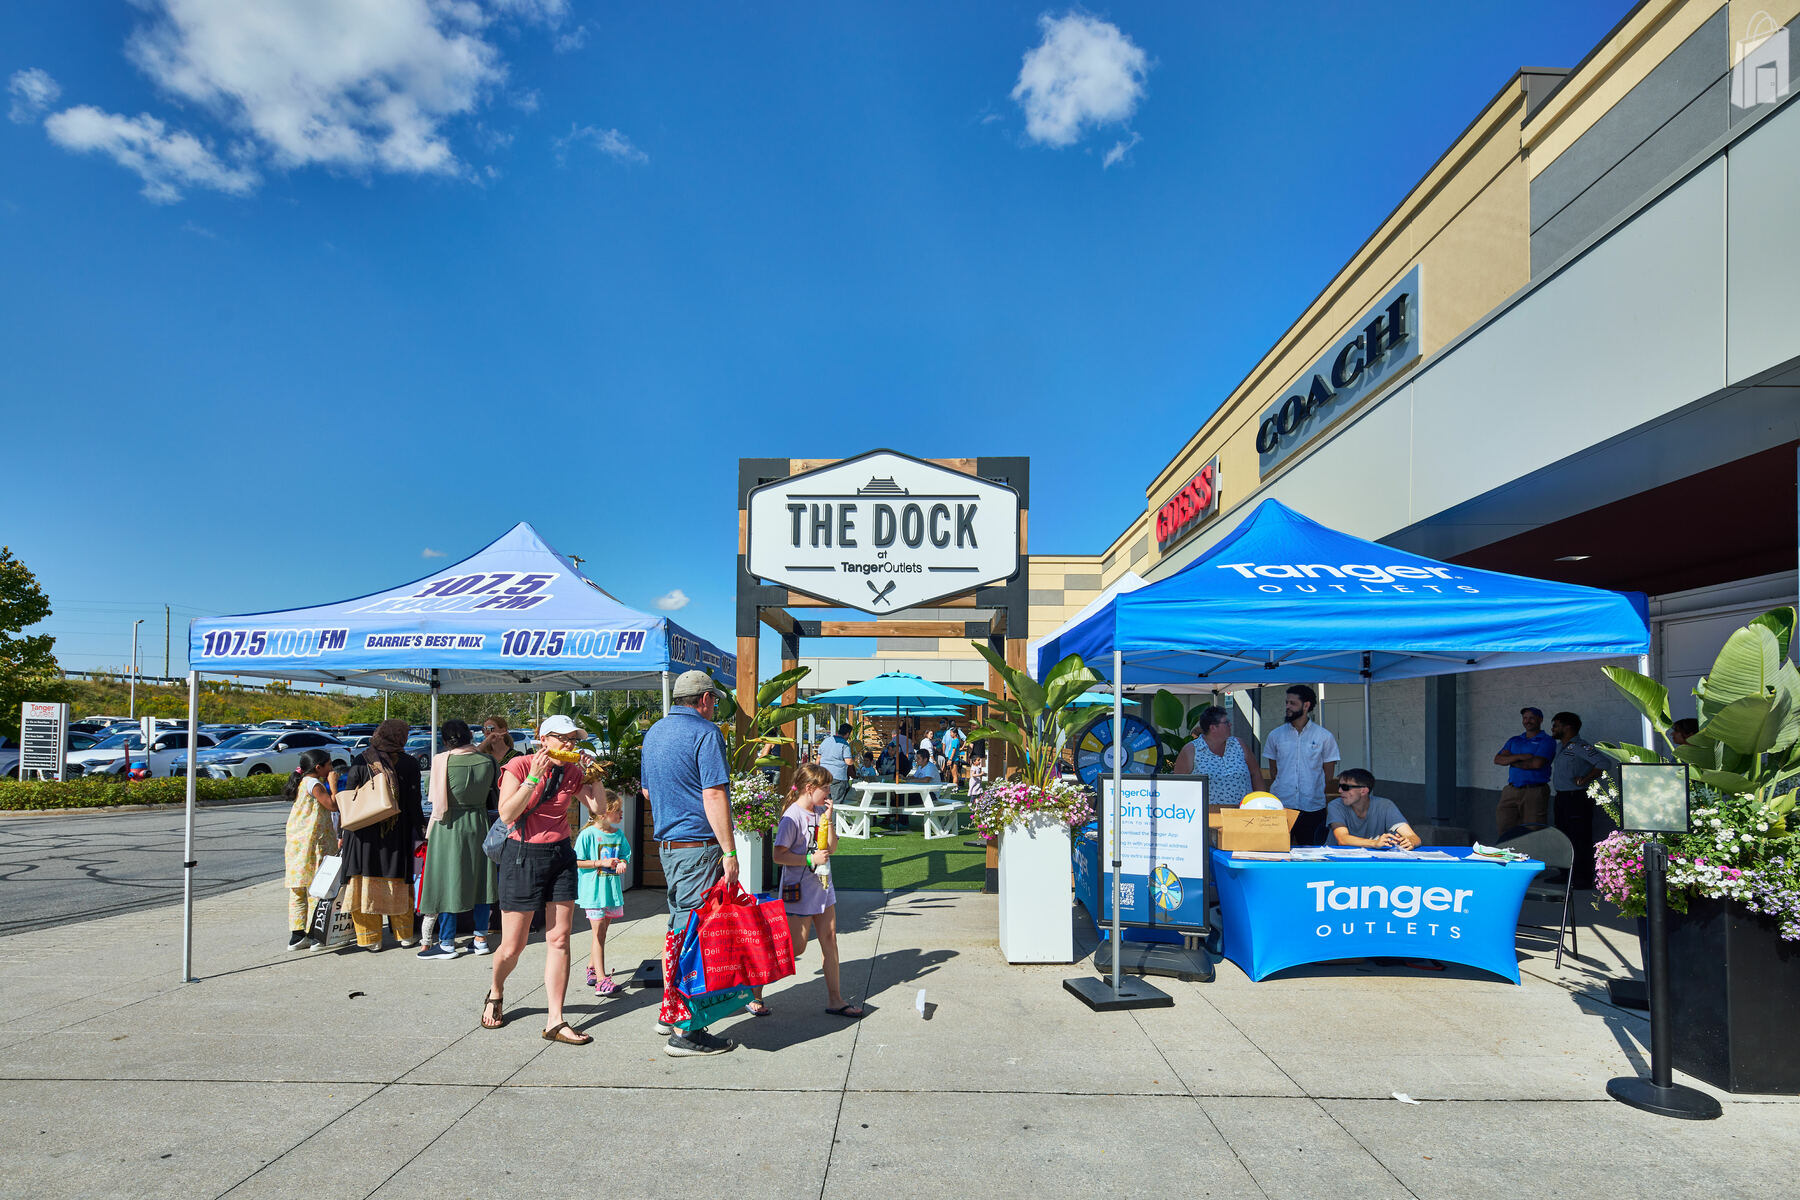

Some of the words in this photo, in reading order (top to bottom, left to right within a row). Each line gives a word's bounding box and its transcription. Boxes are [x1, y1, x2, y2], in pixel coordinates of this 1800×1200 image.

[1255, 293, 1410, 454] COACH
[1156, 465, 1213, 543] GUESS
[786, 503, 858, 548] THE
[872, 503, 979, 549] DOCK
[877, 550, 888, 559] at
[412, 573, 555, 598] 107.5
[1258, 584, 1480, 594] OUTLETS
[472, 595, 549, 610] FM
[203, 631, 266, 656] 107.5
[367, 635, 422, 648] BARRIE'S
[424, 636, 456, 647] BEST
[457, 636, 482, 647] MIX
[503, 631, 565, 656] 107.5
[31, 704, 55, 713] Tanger
[1110, 788, 1161, 799] TngerClub
[1110, 801, 1142, 818] oin
[1146, 803, 1196, 823] today
[1316, 921, 1461, 939] OUTLETS
[735, 936, 760, 944] Centre
[704, 948, 720, 956] Deli
